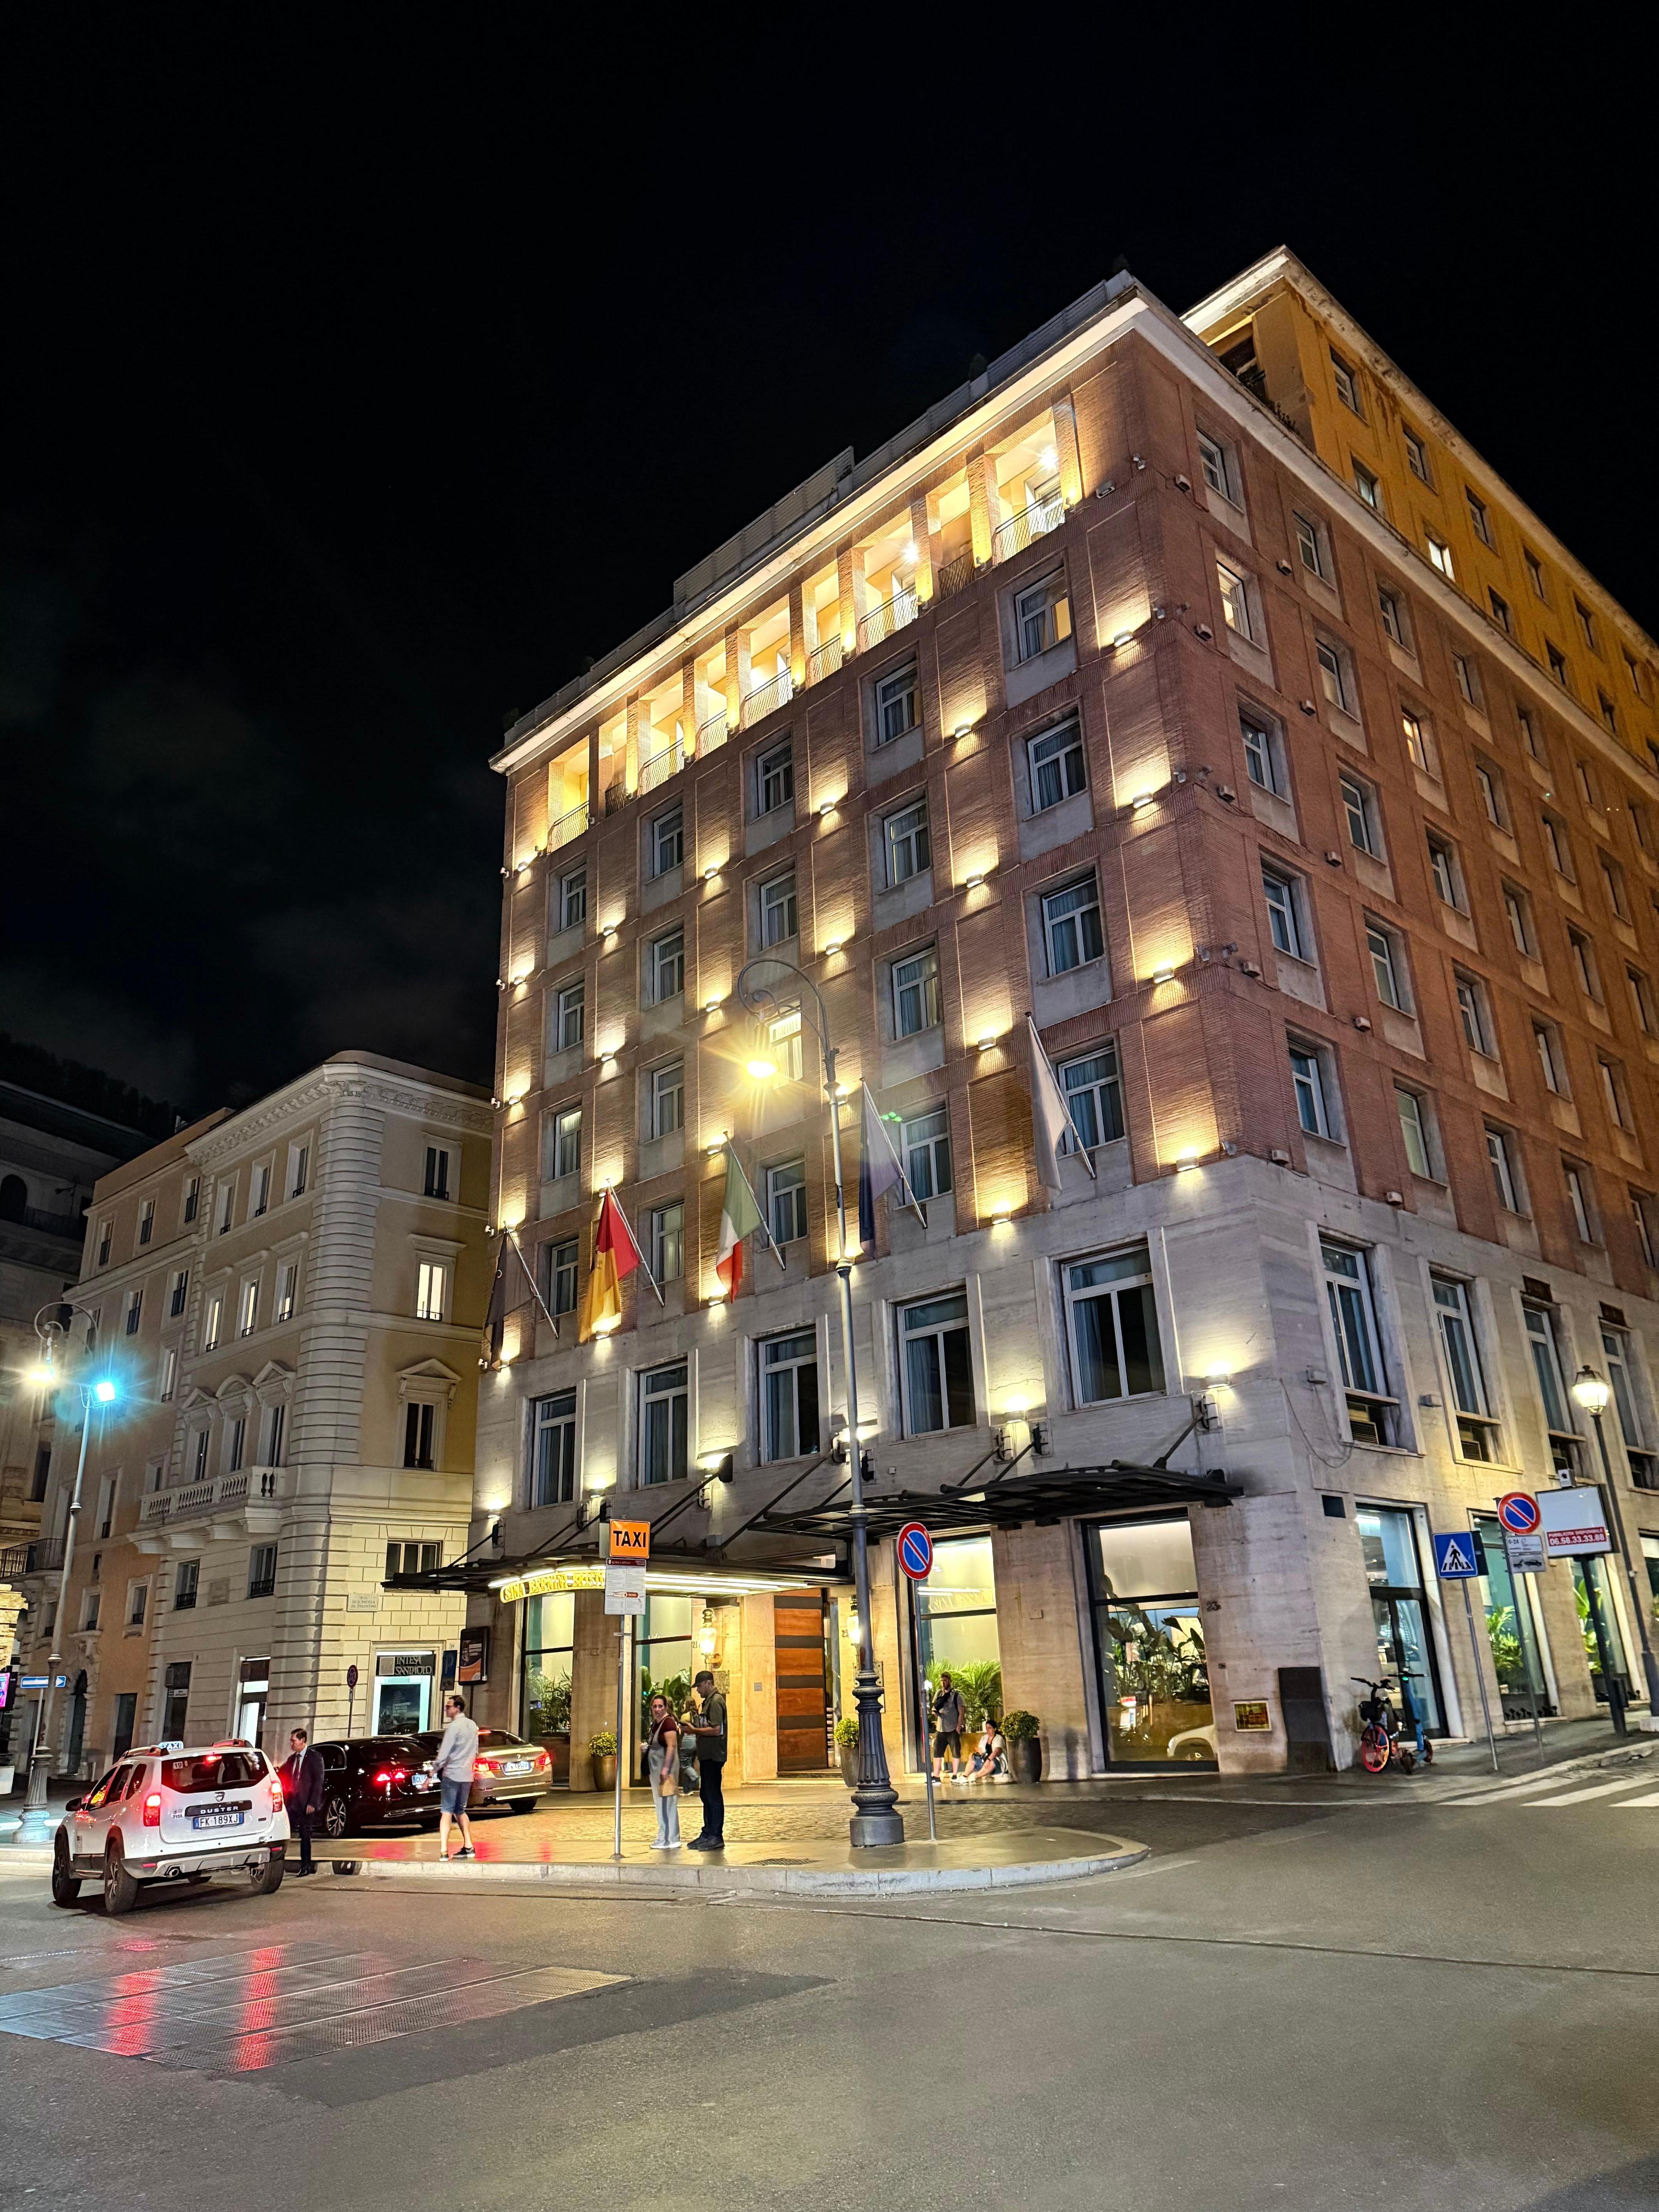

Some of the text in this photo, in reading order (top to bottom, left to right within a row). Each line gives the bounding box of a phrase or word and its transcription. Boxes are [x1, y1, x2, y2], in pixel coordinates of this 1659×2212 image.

[613, 1530, 646, 1548] TAXI
[505, 1583, 526, 1601] SINA
[528, 1574, 568, 1594] BERNINI
[396, 1656, 422, 1665] INTESA
[394, 1666, 432, 1675] SANPAOLO
[200, 1806, 239, 1814] DUSTER
[200, 1814, 238, 1827] FK 189XJ
